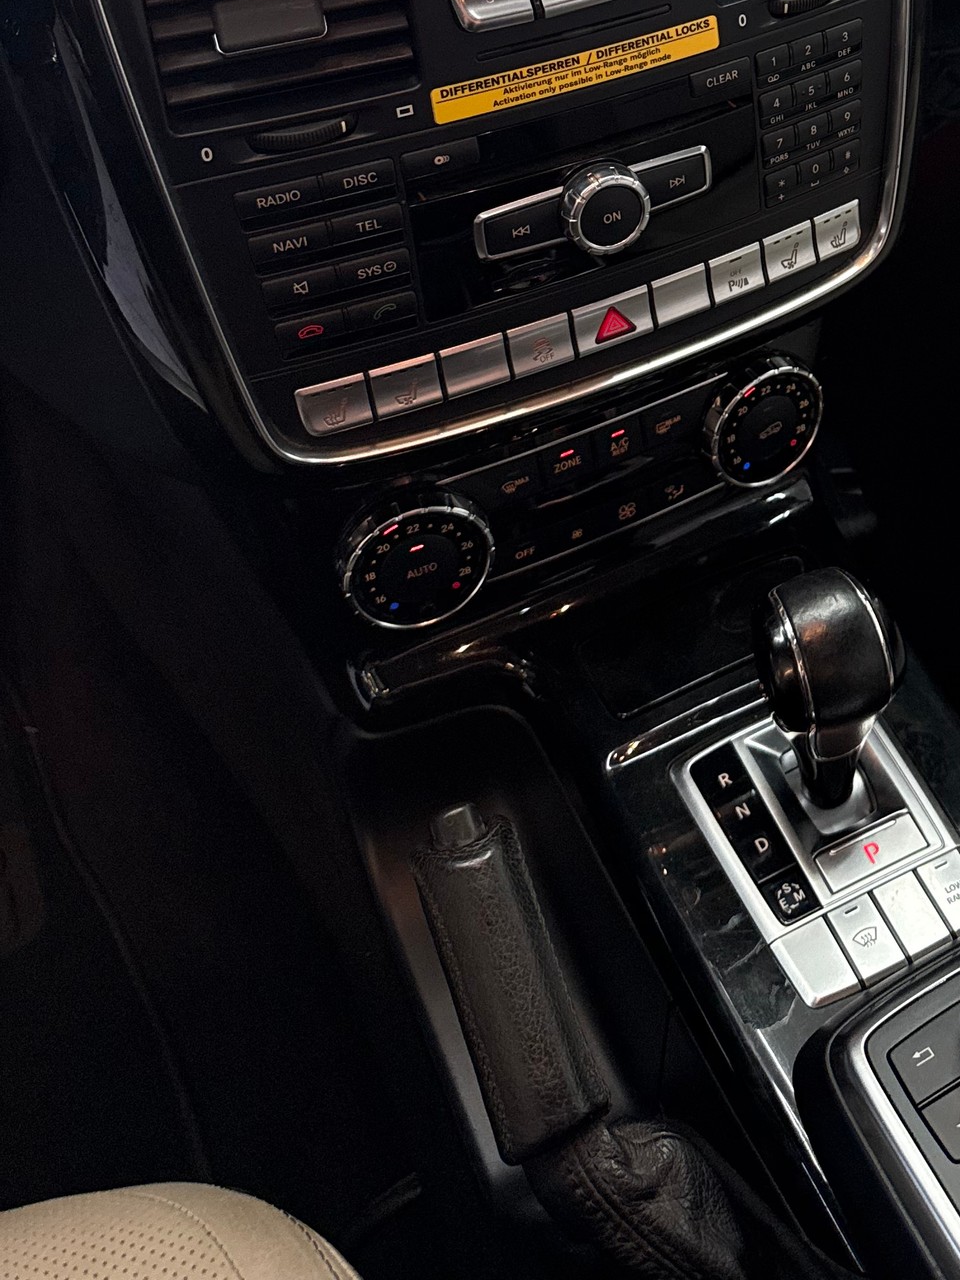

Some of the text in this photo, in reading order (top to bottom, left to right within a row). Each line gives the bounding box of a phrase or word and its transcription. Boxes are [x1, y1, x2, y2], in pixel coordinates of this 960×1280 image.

[841, 31, 849, 42] 3
[804, 45, 812, 56] 2
[838, 46, 852, 58] DEF
[440, 55, 580, 99] DIFFERENTIALSPERREN
[596, 31, 673, 60] DIFFERENTIAL
[675, 19, 710, 39] LOCKS
[503, 46, 661, 95] Aktivierung nur im Low-Range möglich
[801, 60, 816, 72] ABC
[493, 53, 672, 108] Activation only possible in Low-Range mode
[706, 69, 739, 88] CLEAR
[843, 72, 850, 83] 6
[808, 85, 815, 96] 5
[773, 98, 780, 108] 4
[805, 101, 818, 112] JKL
[770, 114, 785, 125] GHI
[844, 111, 851, 122] 9
[810, 125, 818, 136] 8
[776, 138, 784, 149] 7
[806, 140, 821, 151] TUV
[343, 172, 378, 189] DISC
[256, 190, 301, 208] RADIO
[603, 210, 622, 225] ON
[355, 219, 382, 233] TEL
[273, 236, 308, 253] NAVI
[357, 265, 382, 279] SYS
[538, 352, 554, 364] OFF
[609, 436, 630, 452] A/C
[553, 454, 582, 474] ZONE
[406, 523, 421, 535] 22
[440, 522, 455, 533] 24
[376, 543, 391, 554] 20
[461, 540, 474, 551] 26
[514, 545, 536, 561] OFF
[364, 571, 377, 583] 18
[406, 562, 438, 580] AUTO
[458, 566, 472, 577] 28
[374, 594, 388, 605] 16
[717, 772, 733, 789] R
[735, 803, 751, 820] N
[754, 837, 769, 854] D
[863, 842, 880, 864] P
